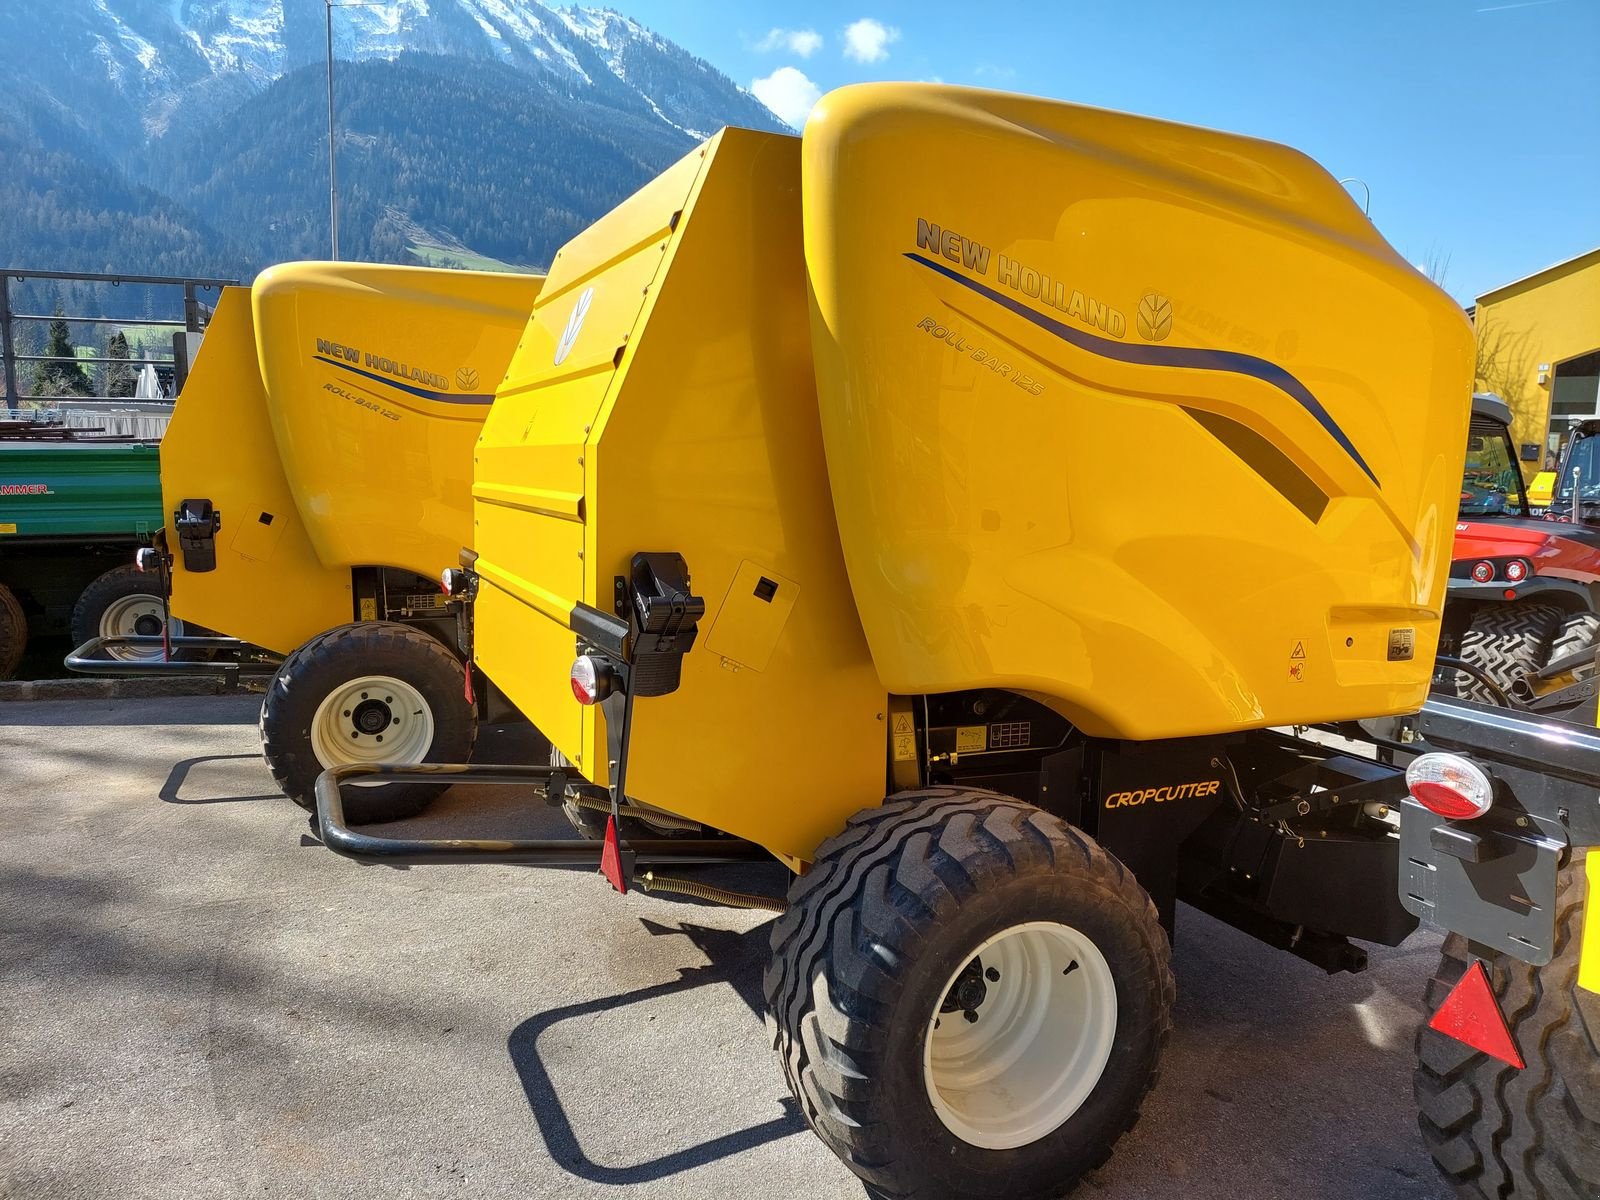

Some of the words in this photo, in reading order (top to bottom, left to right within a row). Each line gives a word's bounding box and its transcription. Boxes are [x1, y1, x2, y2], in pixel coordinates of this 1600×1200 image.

[917, 218, 989, 275] NEW
[998, 255, 1126, 339] HOLLAND
[316, 338, 360, 363] NEW
[365, 353, 449, 390] HOLLAND
[917, 317, 1012, 377] ROLL-BAR
[1010, 369, 1046, 396] 125
[323, 383, 380, 413] ROLL-BAR
[380, 408, 402, 421] 125
[0, 484, 47, 495] MMER
[1105, 780, 1220, 809] CROPCUTTER
